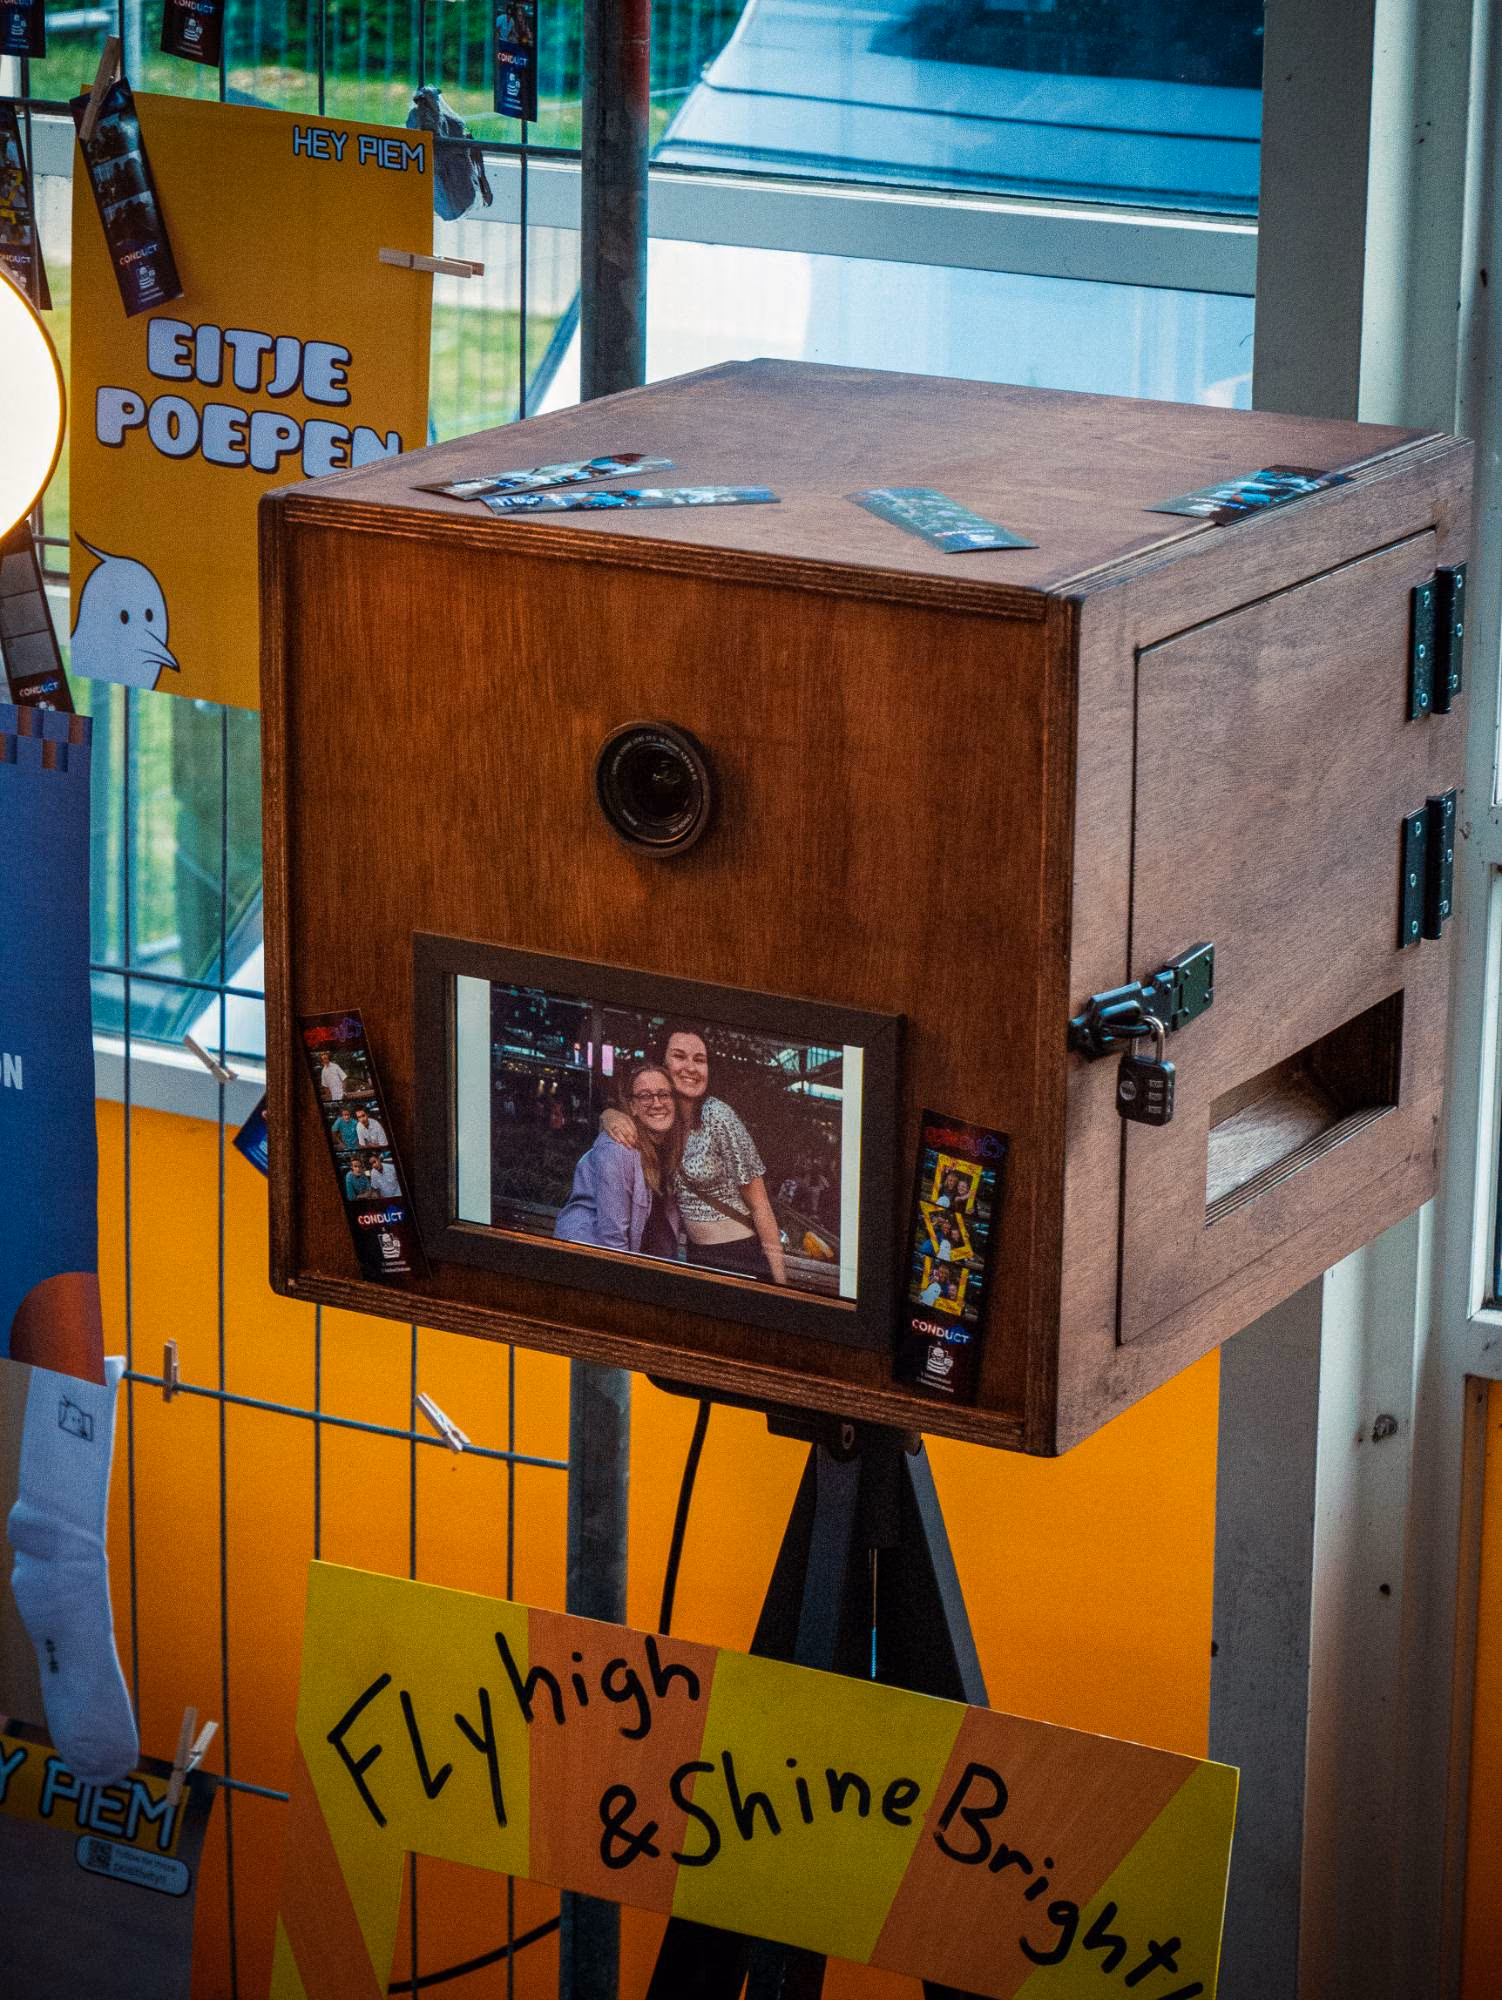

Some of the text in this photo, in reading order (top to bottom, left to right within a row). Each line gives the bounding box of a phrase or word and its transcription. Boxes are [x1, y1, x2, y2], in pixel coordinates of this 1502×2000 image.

[293, 125, 425, 174] HEY PIEM
[119, 243, 159, 266] CONDUCT
[146, 316, 352, 408] EITJE
[95, 385, 403, 478] POEPEN
[19, 681, 60, 697] CONDUCT
[357, 1210, 403, 1225] CONDUCT
[912, 1318, 970, 1344] CONDUCT
[495, 1631, 700, 1740] high
[39, 1755, 178, 1850] PIEM
[669, 1750, 921, 1867] Shine
